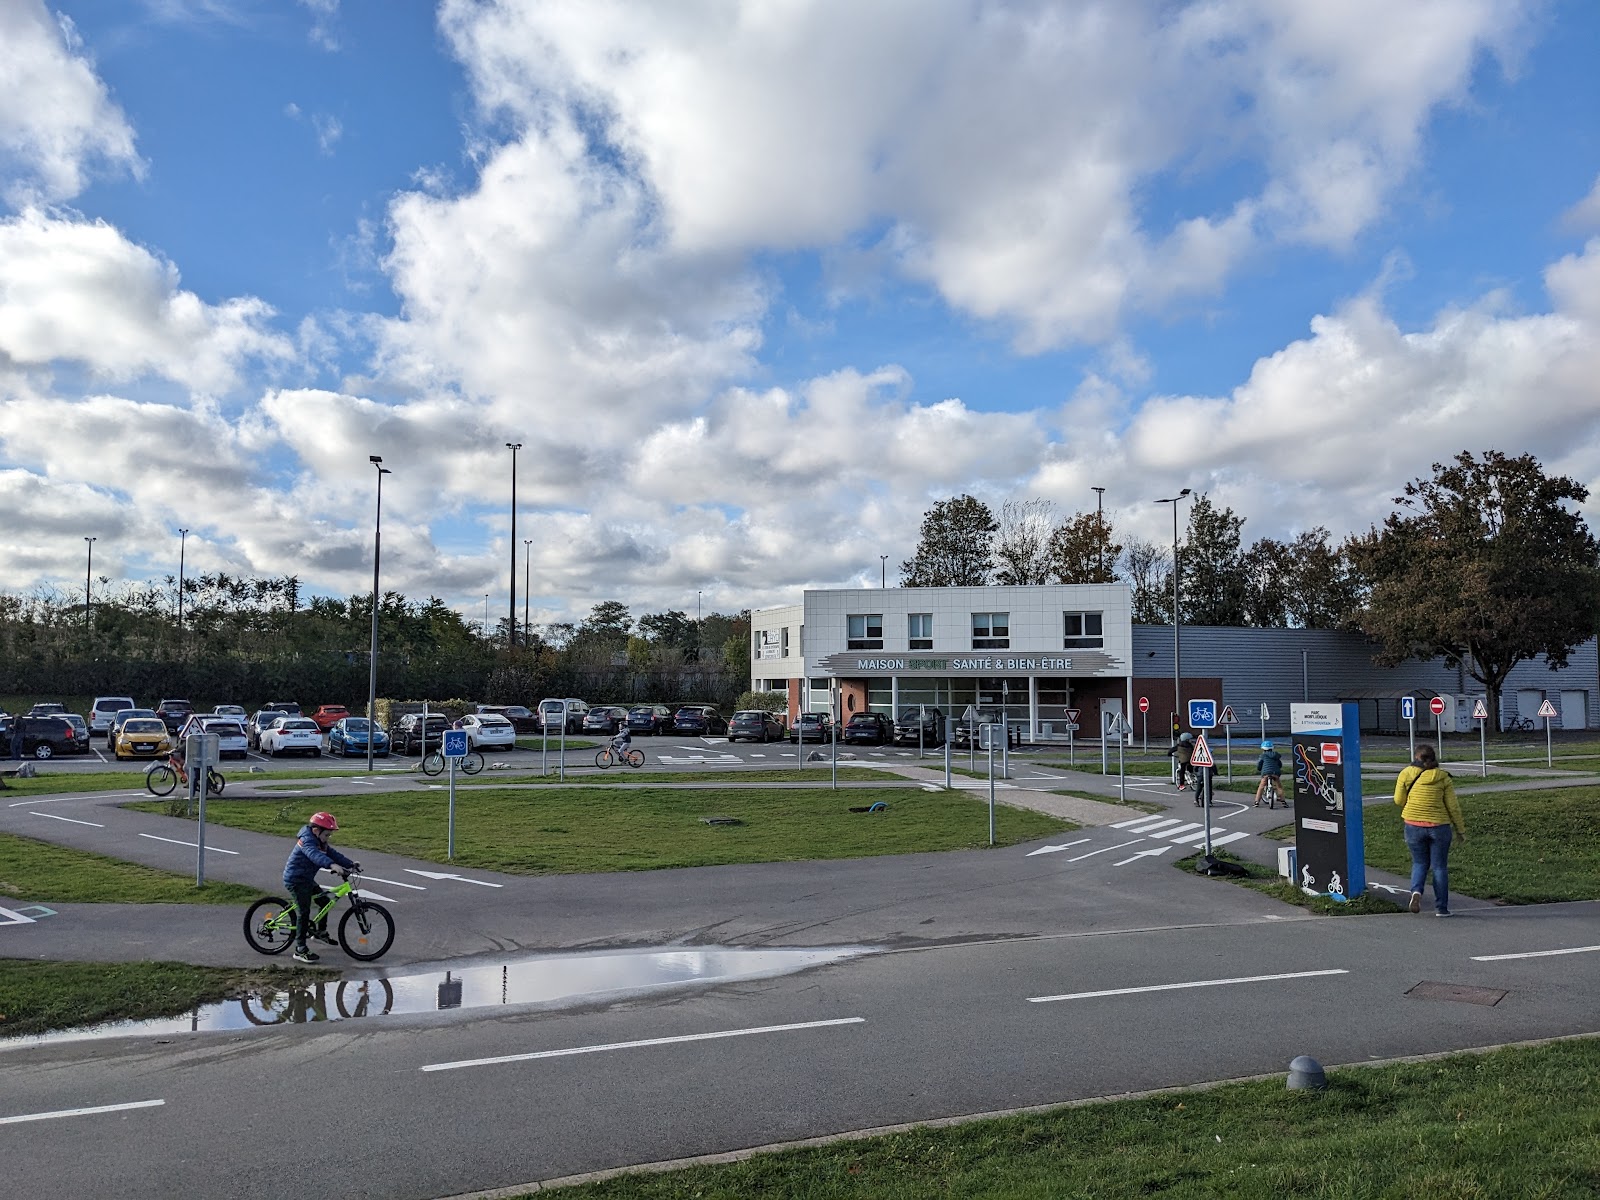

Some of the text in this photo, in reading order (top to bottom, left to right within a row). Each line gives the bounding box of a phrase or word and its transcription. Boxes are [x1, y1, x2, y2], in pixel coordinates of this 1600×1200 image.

[858, 656, 1072, 670] MAISON SPORT SANTÉ & BIEN-ÊTRE
